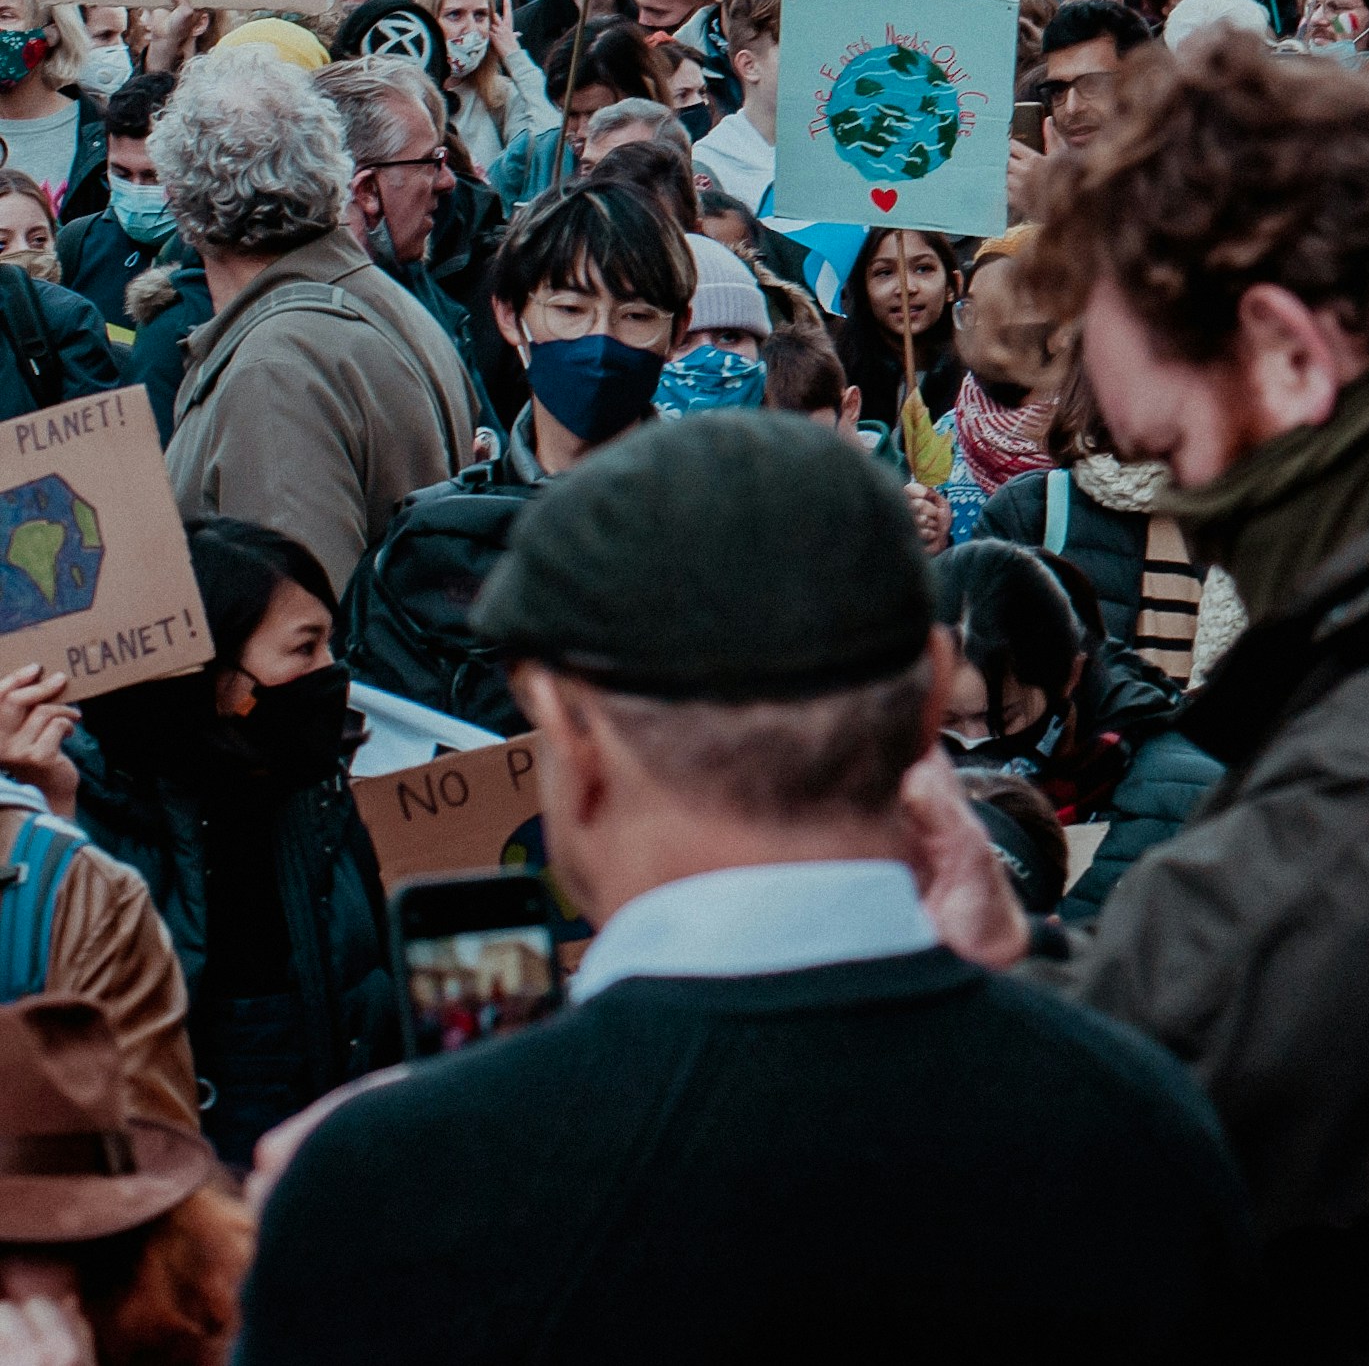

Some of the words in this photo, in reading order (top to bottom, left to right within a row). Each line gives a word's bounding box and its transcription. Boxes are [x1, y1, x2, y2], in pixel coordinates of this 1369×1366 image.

[15, 394, 128, 456] PLANET!
[66, 609, 199, 679] PLANET!
[396, 768, 470, 824] NO
